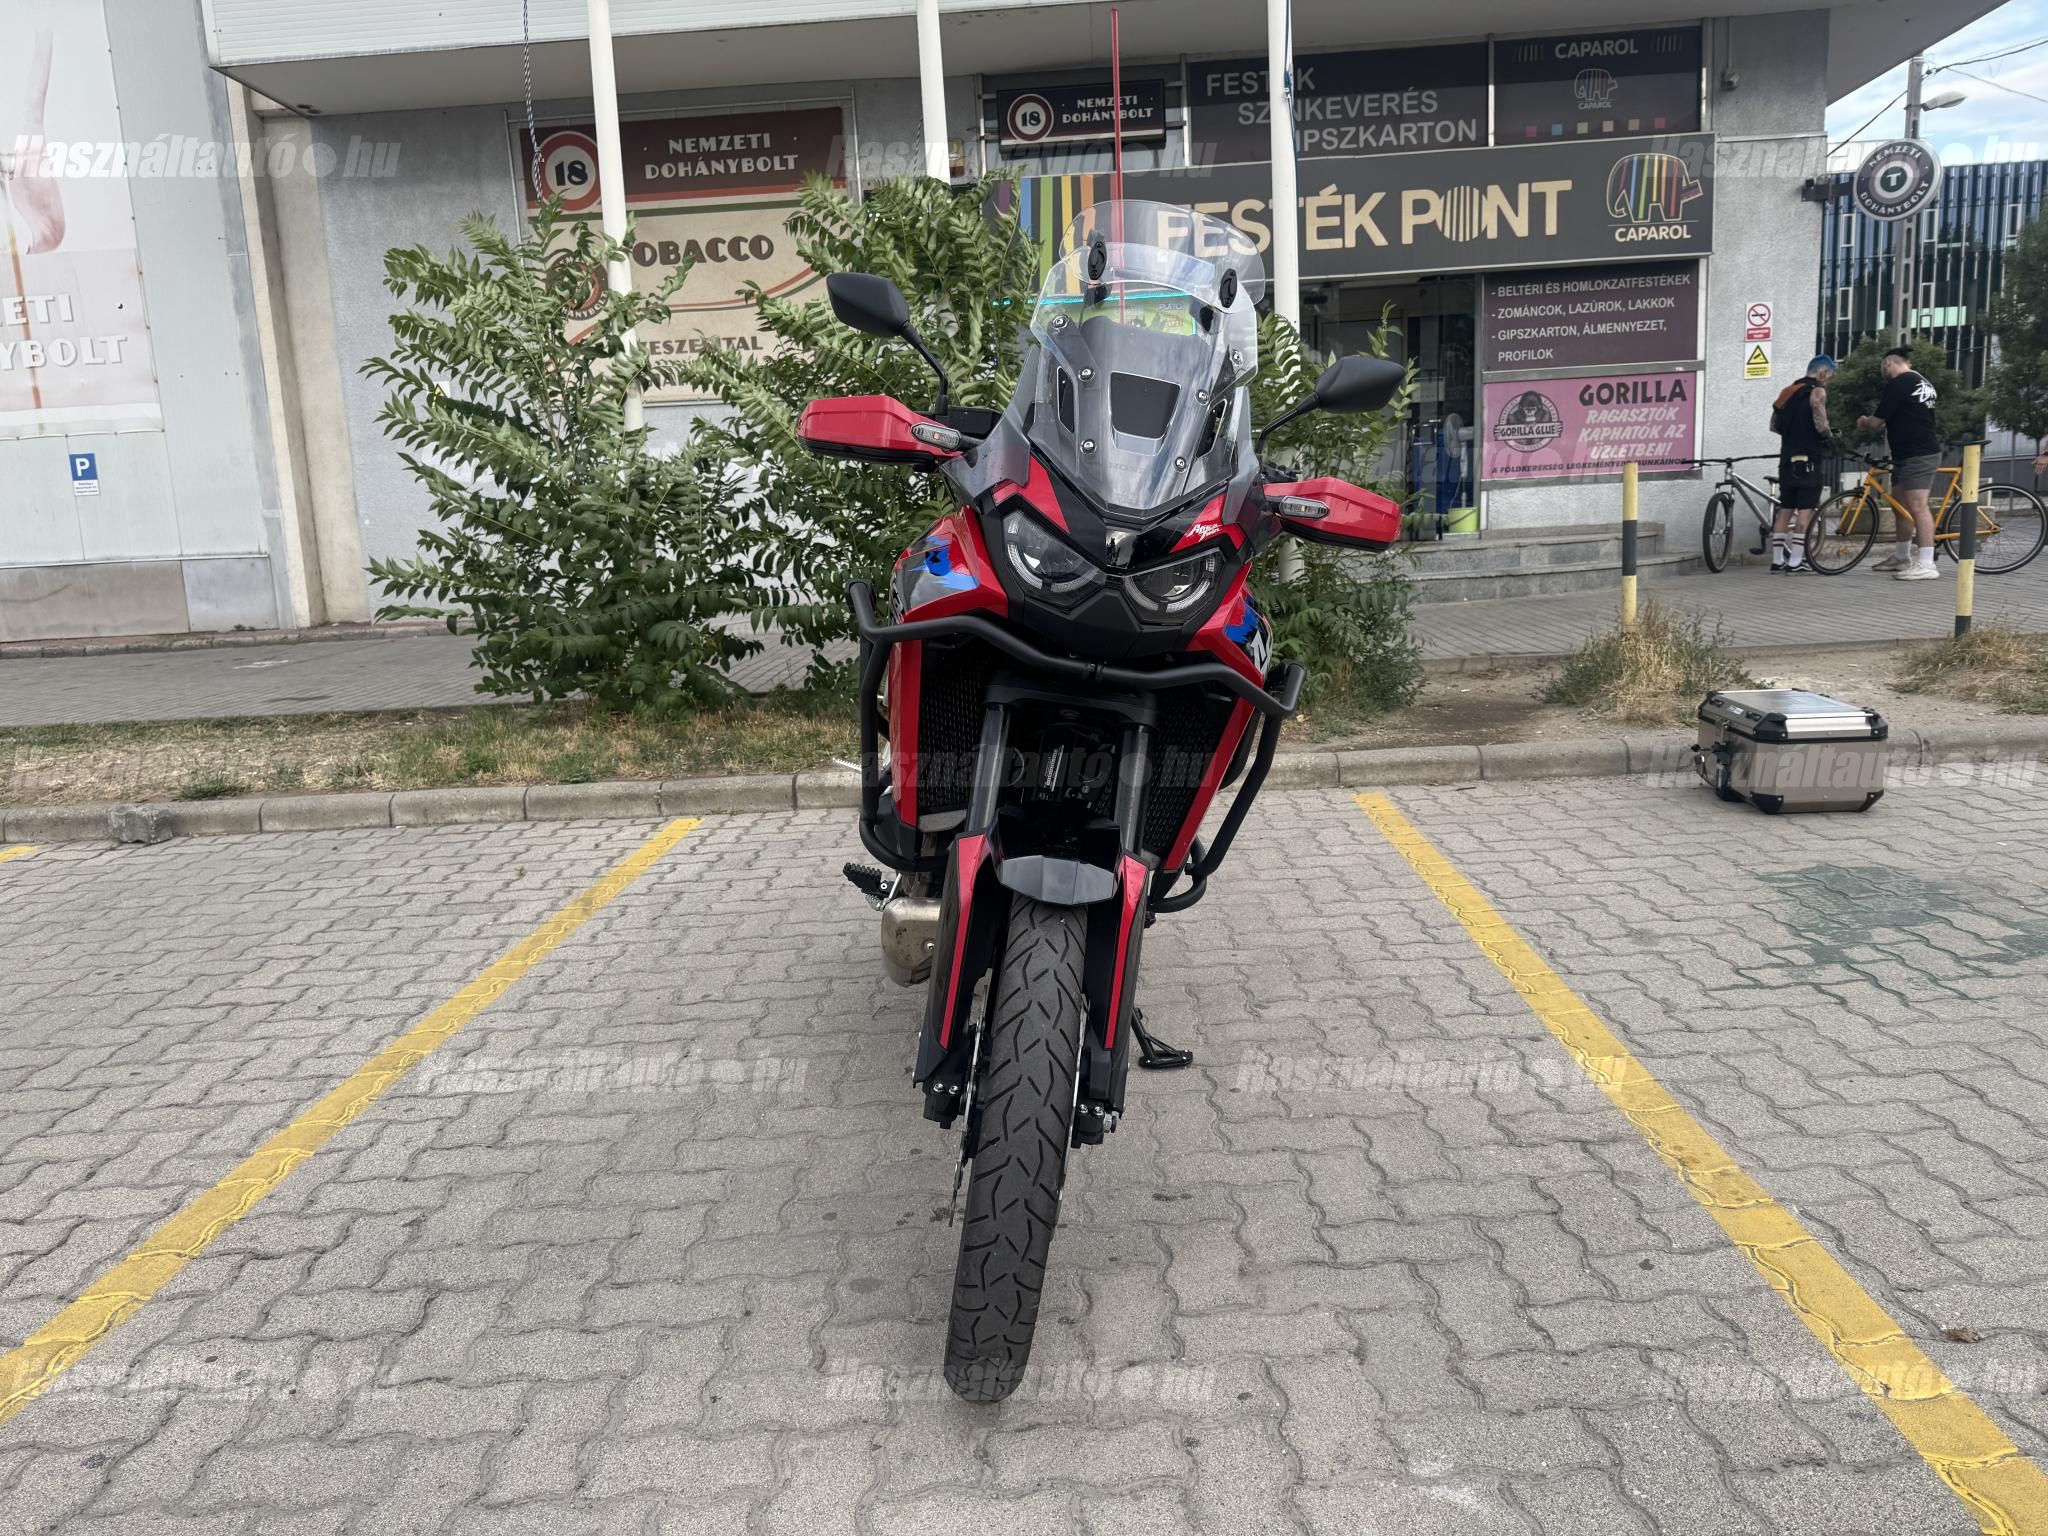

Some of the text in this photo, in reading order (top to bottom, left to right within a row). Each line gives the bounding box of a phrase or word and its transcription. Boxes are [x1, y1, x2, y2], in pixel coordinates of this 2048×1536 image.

[1554, 38, 1639, 59] CAPAROL
[1206, 68, 1316, 97] FESTK
[1238, 87, 1438, 126] SZNKEVERÉS
[1577, 100, 1612, 110] CAPAROL
[1020, 110, 1041, 127] 18
[668, 132, 771, 156] NEMZETI
[1296, 118, 1477, 153] IPSZKARTON
[644, 154, 799, 180] DOHÁNYBOLT
[1868, 145, 1922, 168] NEMZETI
[554, 160, 589, 187] 18
[1157, 179, 1573, 264] FESÉK PONT
[1614, 224, 1692, 242] CAPAROL
[632, 235, 775, 268] OBACCO
[1497, 282, 1543, 297] BELTÉRI
[1545, 280, 1560, 294] ÉS
[1562, 273, 1691, 293] HOMLOKZATFESTÉKEK
[0, 294, 74, 327] ETI
[1497, 303, 1566, 319] ZOMÁNCOK,
[1628, 296, 1676, 310] LAKKOK
[1497, 325, 1580, 341] GIPSZKARTON,
[1497, 348, 1554, 363] PROFILOK
[1578, 379, 1688, 407] GORILLA
[1585, 404, 1680, 425] RAGASZTÓK
[1500, 425, 1556, 437] GORILLA GLUE
[1578, 422, 1687, 443] KAPHATÓK AZ
[75, 457, 90, 477] P
